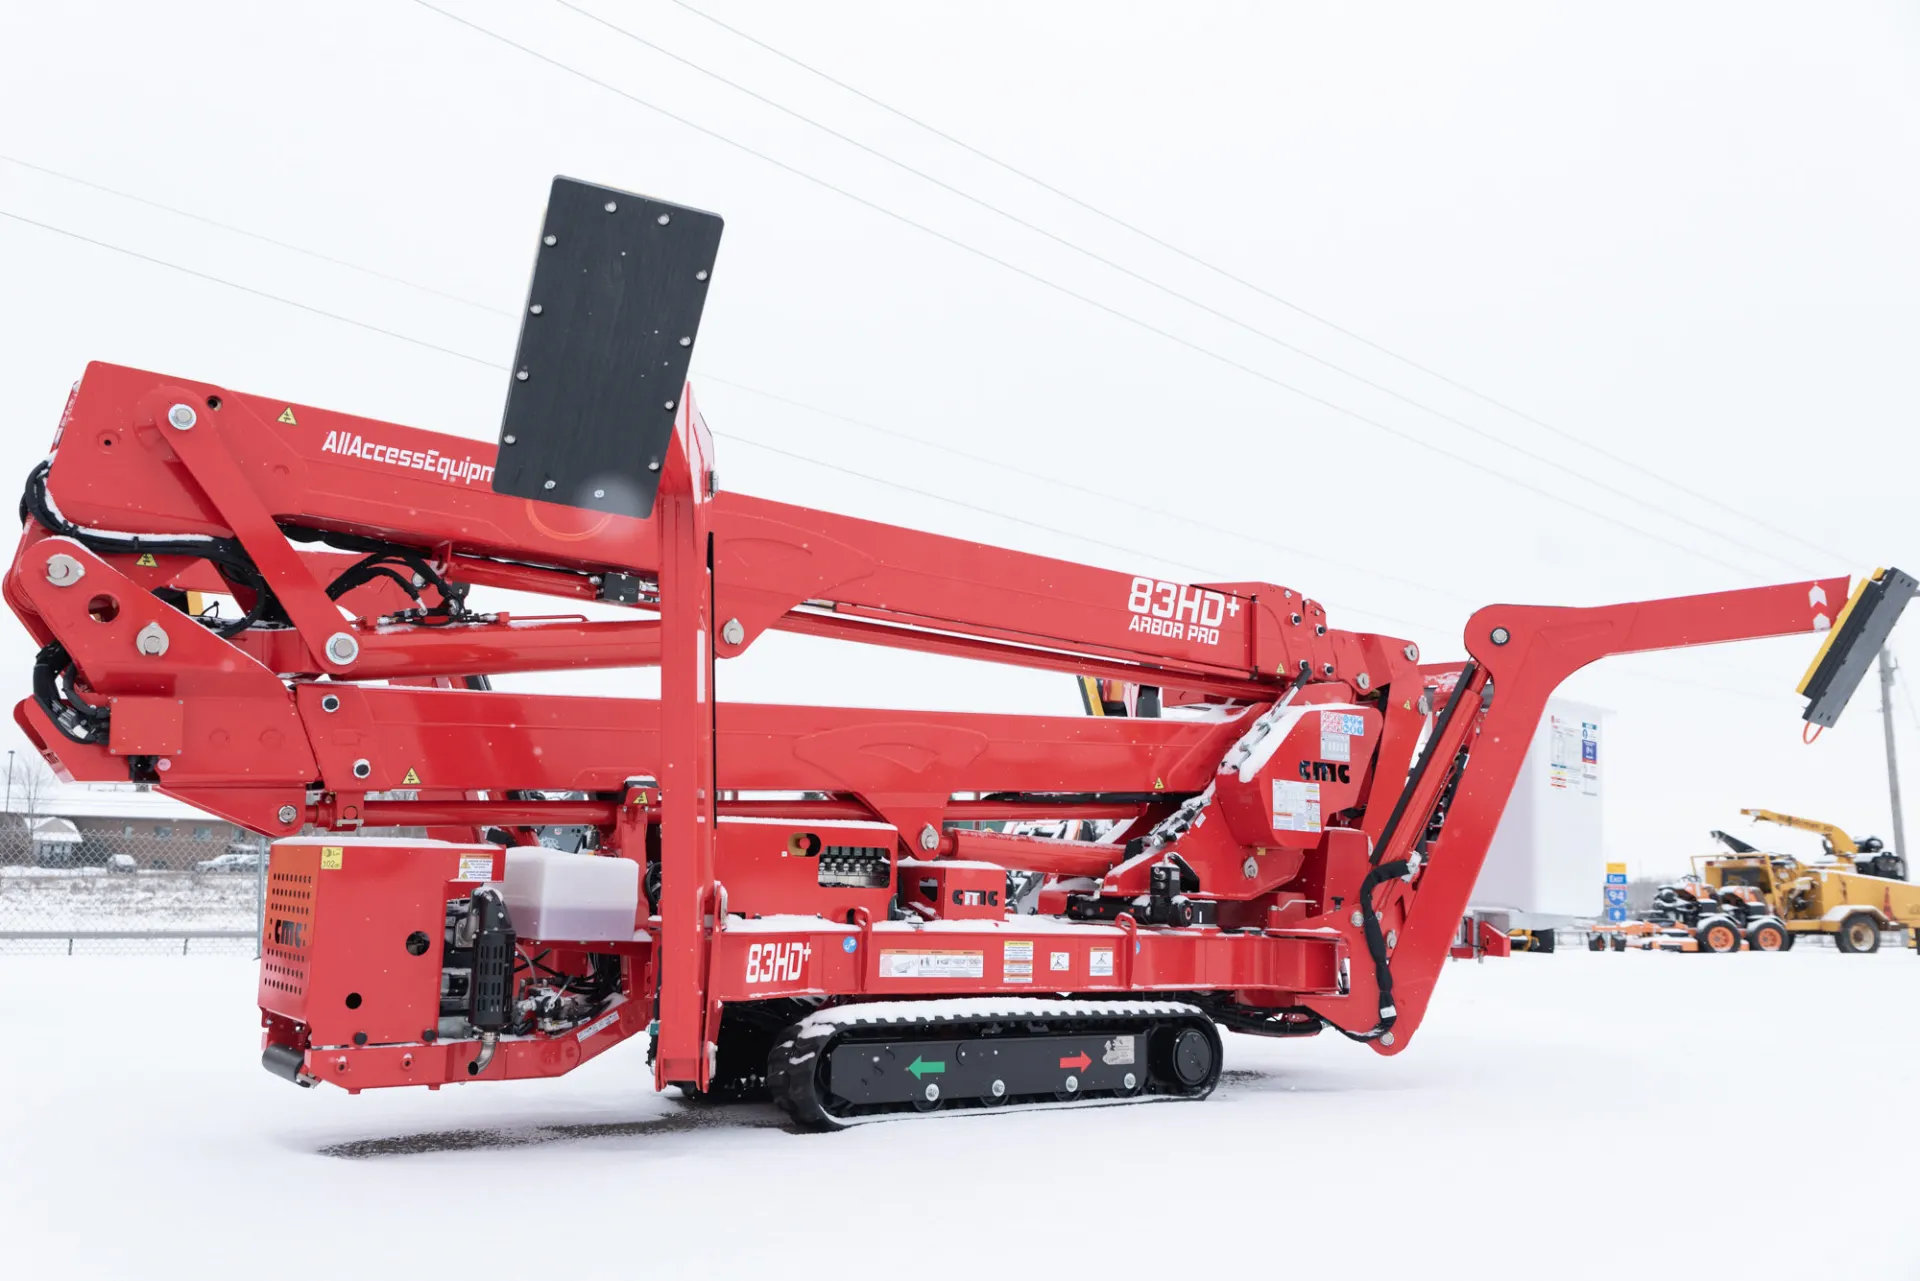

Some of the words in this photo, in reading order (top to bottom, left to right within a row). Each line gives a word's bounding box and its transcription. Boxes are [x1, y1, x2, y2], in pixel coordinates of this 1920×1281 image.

[1128, 576, 1240, 628] 83HD+
[1128, 614, 1185, 640] ARBOR
[1187, 624, 1220, 646] PRO
[1609, 890, 1625, 901] 94
[745, 941, 812, 984] 83HD+
